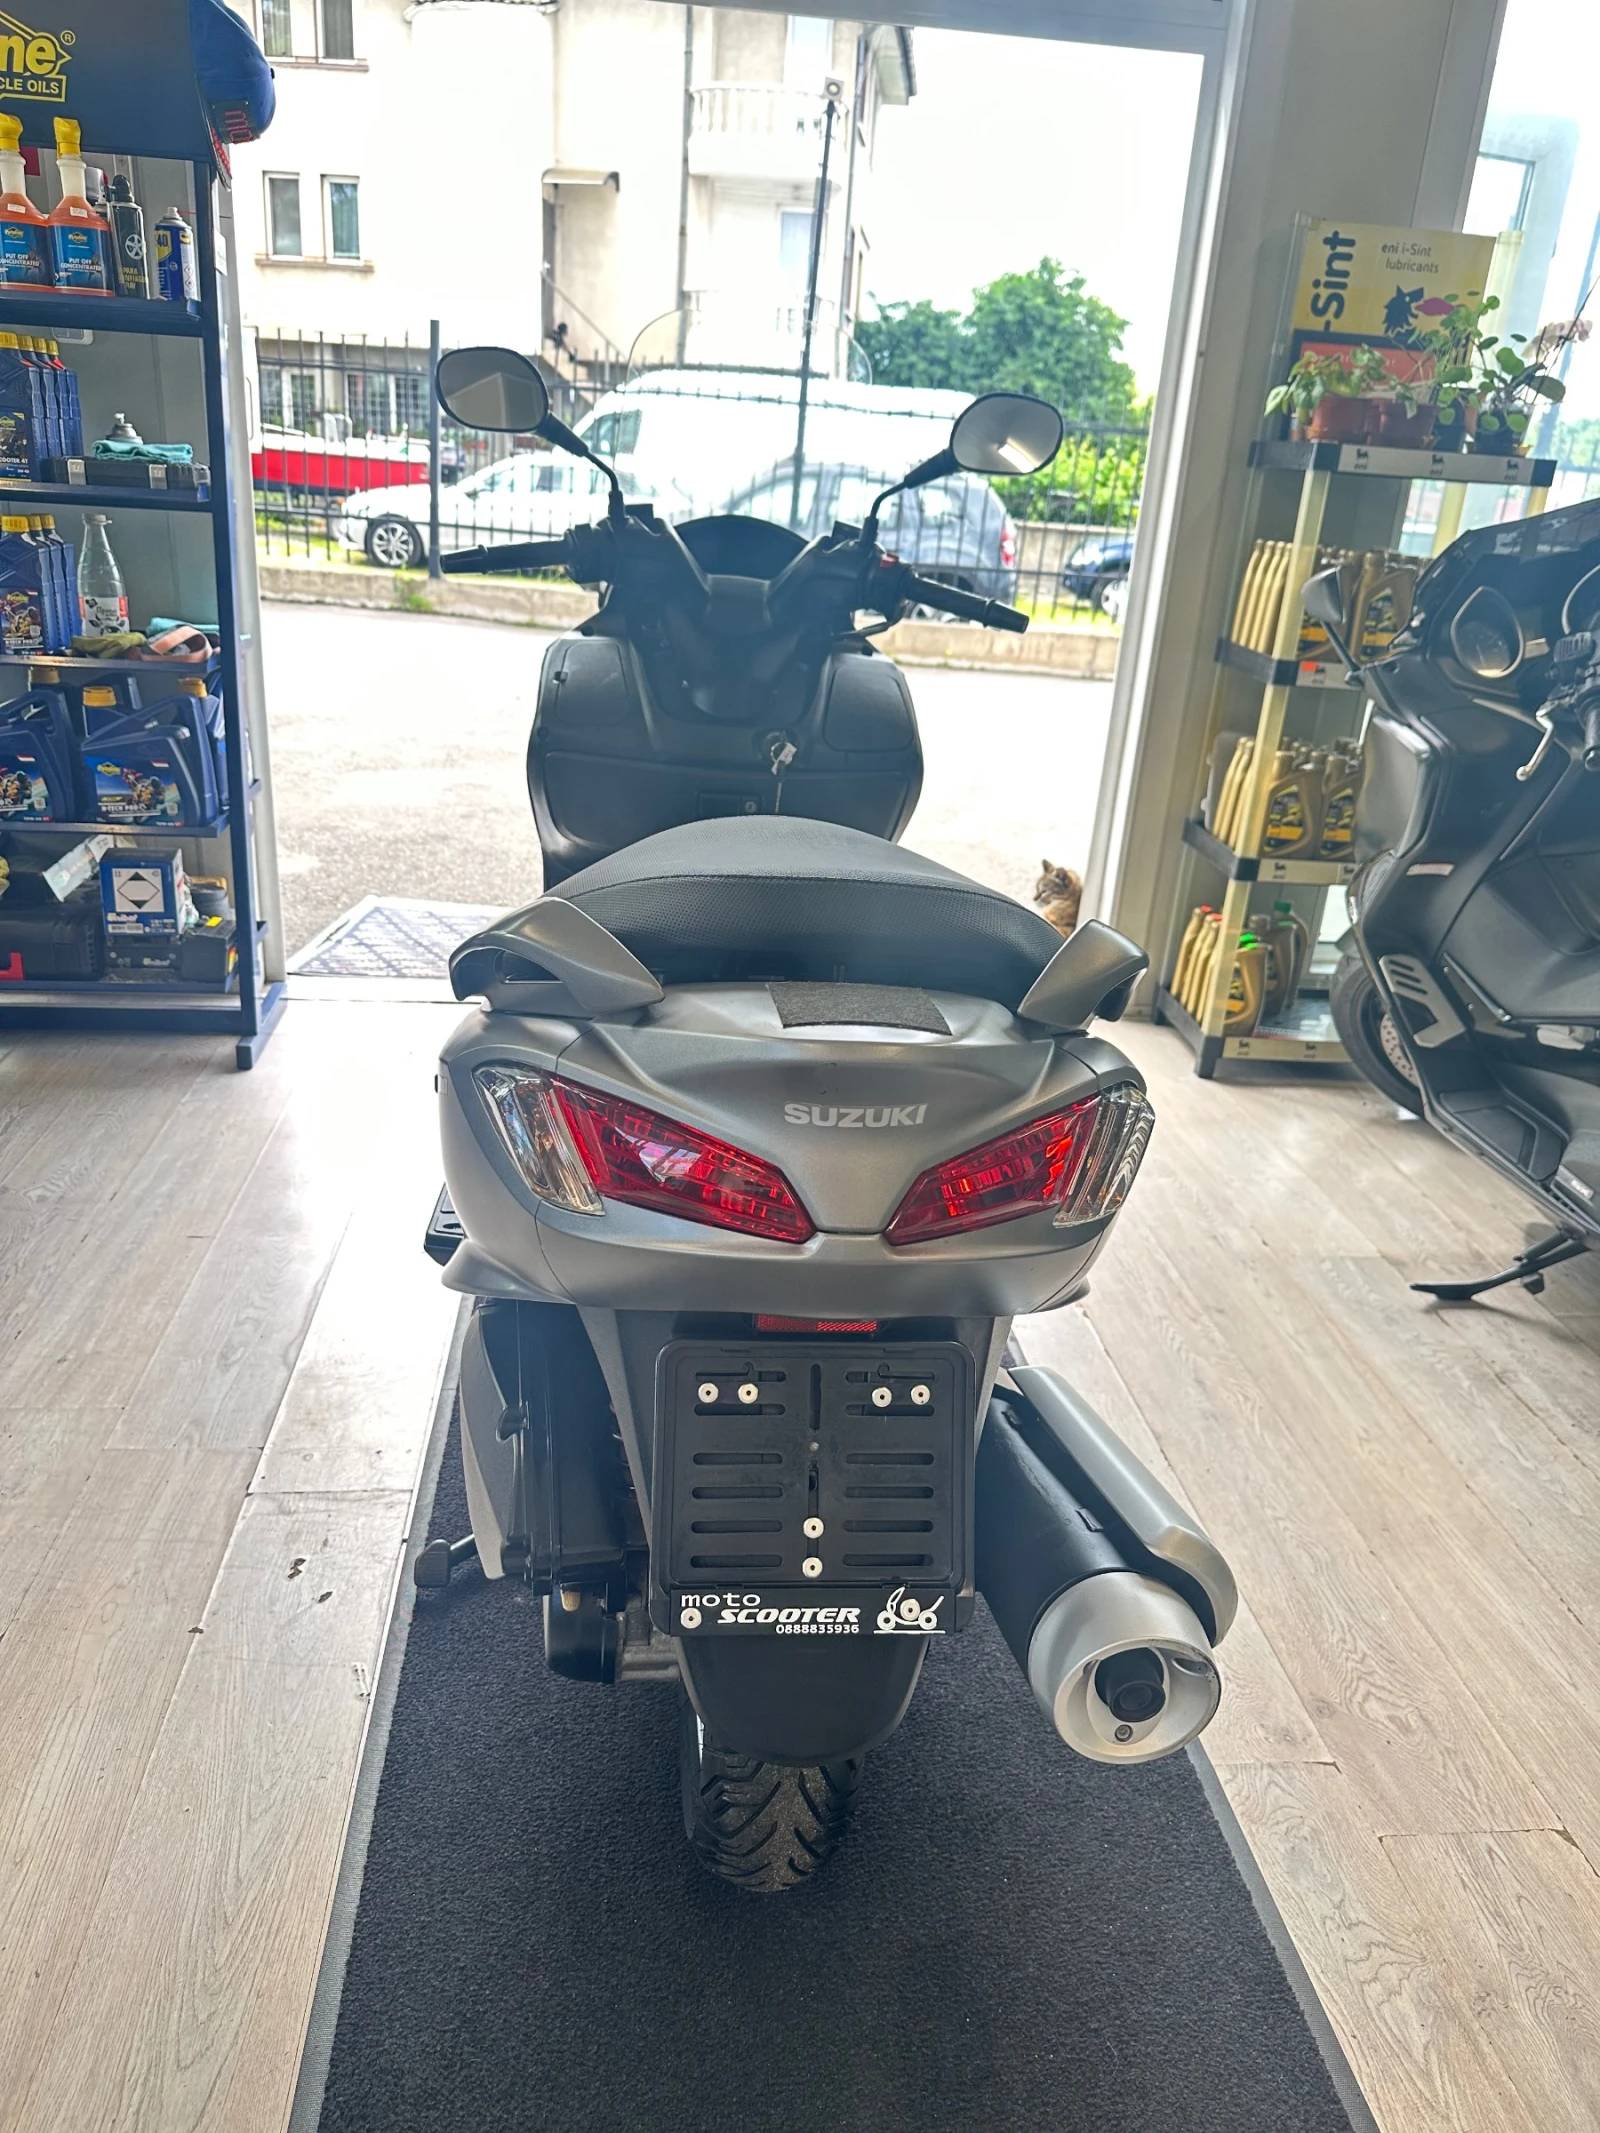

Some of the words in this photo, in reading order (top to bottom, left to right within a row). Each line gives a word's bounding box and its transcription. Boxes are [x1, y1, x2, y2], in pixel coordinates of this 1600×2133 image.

[27, 80, 60, 94] OILS
[1381, 242, 1400, 255] eni
[60, 262, 103, 273] CONCENTRATED
[1385, 257, 1440, 274] lubricants
[784, 1102, 928, 1128] SUZUKI
[681, 1592, 761, 1607] moto
[717, 1607, 861, 1624] SCOOTER
[776, 1624, 860, 1635] 0888835936
